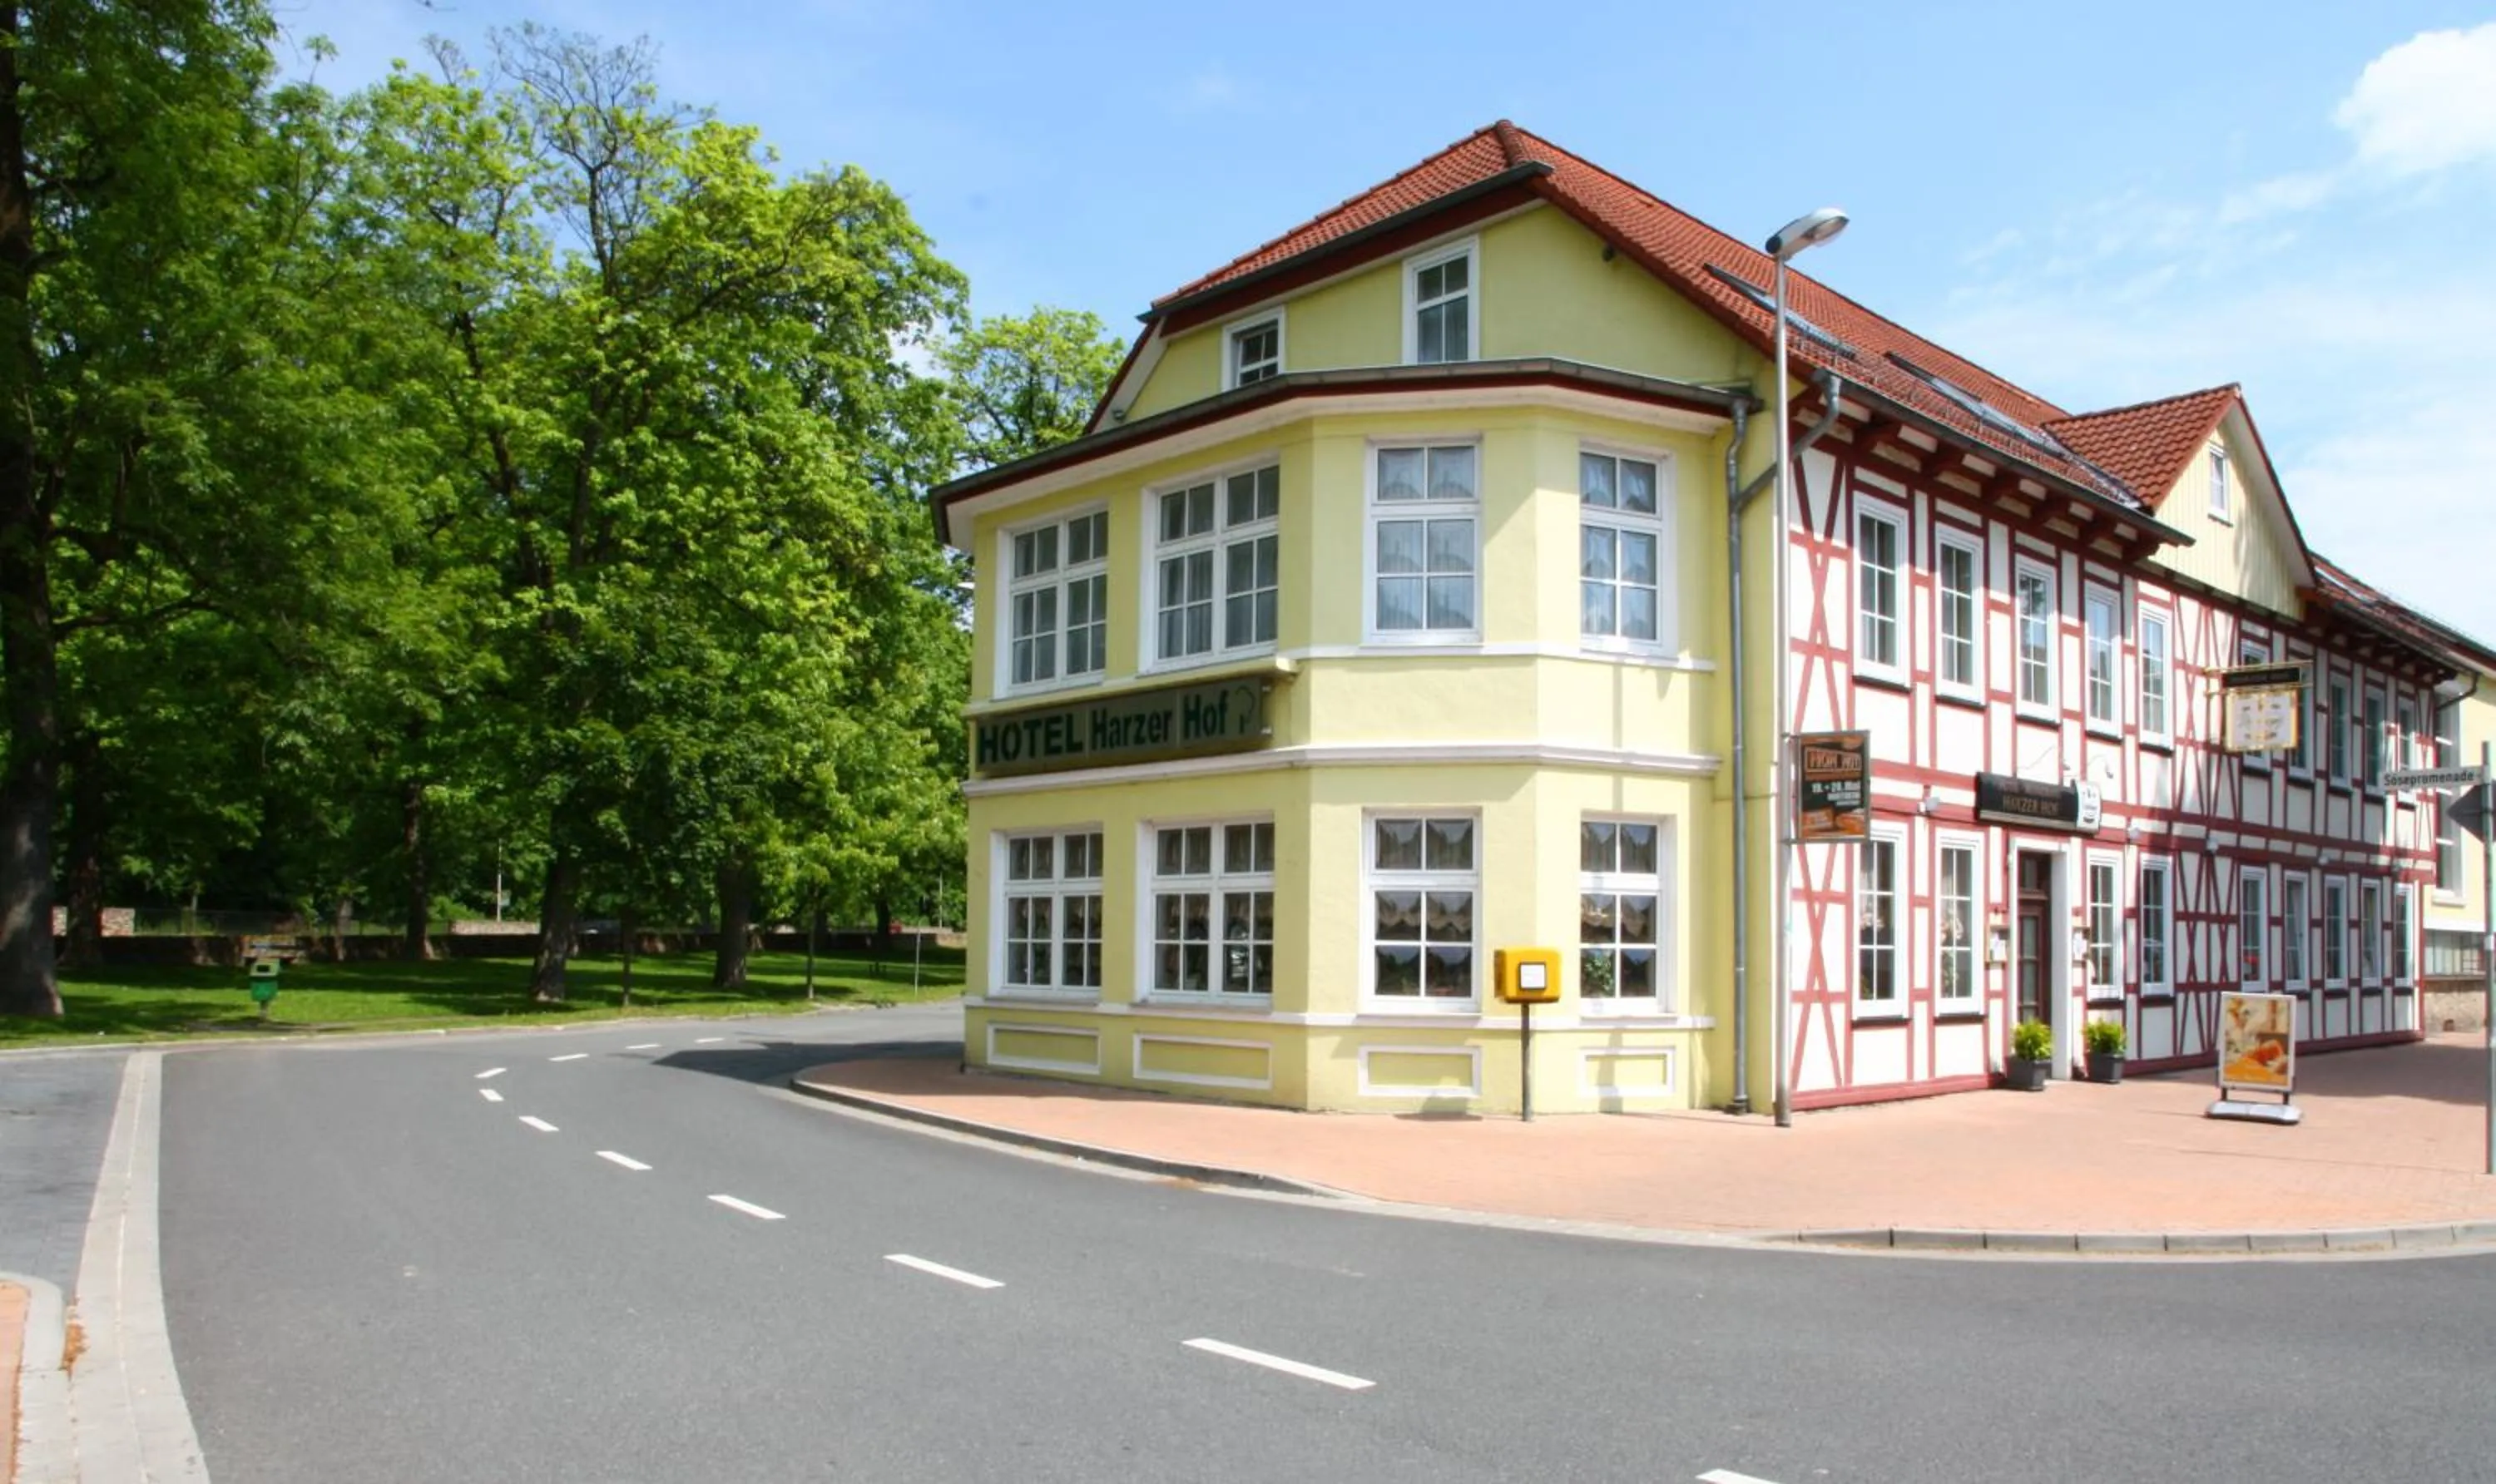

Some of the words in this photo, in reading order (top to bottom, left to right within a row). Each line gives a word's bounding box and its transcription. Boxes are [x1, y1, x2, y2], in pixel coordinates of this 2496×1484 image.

[979, 712, 1083, 764] HOTEL
[1091, 708, 1173, 750] Harzer
[1183, 689, 1230, 740] Hof
